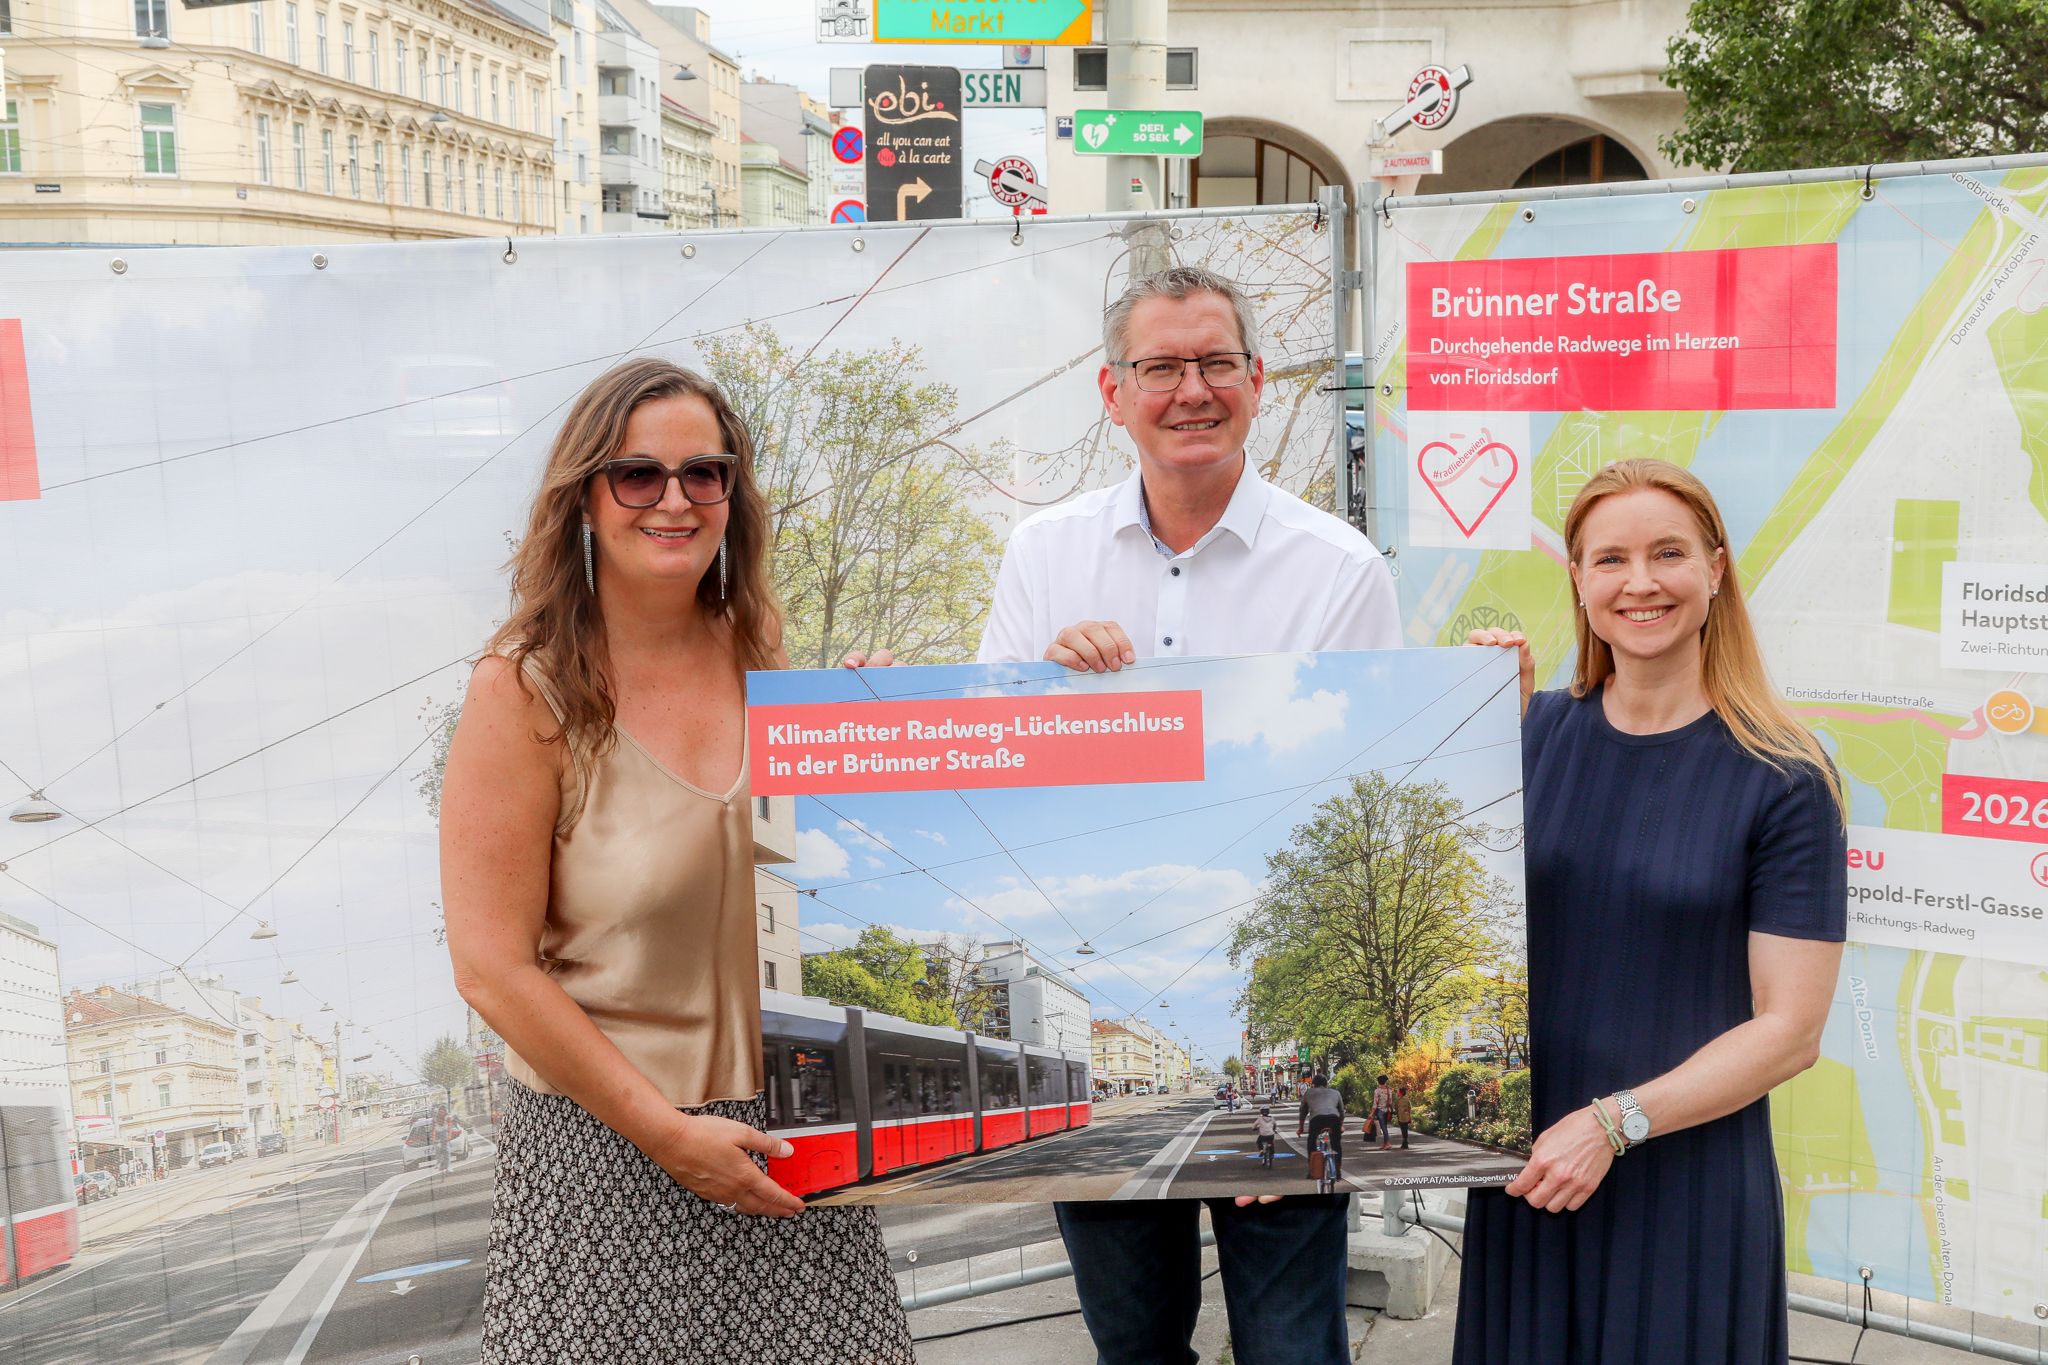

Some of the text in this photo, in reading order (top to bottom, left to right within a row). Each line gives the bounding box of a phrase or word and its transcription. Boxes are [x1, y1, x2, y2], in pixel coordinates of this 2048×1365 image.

[931, 9, 1004, 33] Markt
[965, 74, 1022, 103] SSEN
[1408, 70, 1441, 100] TABAK
[1419, 90, 1450, 125] TRAFIK
[877, 132, 950, 149] all you can eat
[1139, 124, 1164, 132] DEFI
[1149, 133, 1170, 142] SEK
[899, 150, 907, 164] à
[909, 149, 920, 164] la
[923, 153, 951, 164] carte
[998, 160, 1034, 179] TABAK
[1390, 157, 1430, 167] AUTOMATEN
[992, 178, 1025, 203] TRAFIK
[1431, 279, 1682, 318] Brünner Straße
[1950, 233, 2039, 346] Donauufer Autobahn
[1373, 320, 1400, 365] andelskai
[1430, 331, 1740, 358] Durchgehende Radwege im Herzen
[1430, 367, 1558, 385] von Floridsdorf
[1432, 437, 1486, 480] #radliebewien
[1963, 582, 2048, 603] Floridsd
[1962, 609, 2048, 634] Hauptst
[1785, 686, 1934, 709] Floridsdorfer Hauptstraße
[767, 711, 1185, 745] Klimafitter Radweg-Lückenschluss
[769, 746, 1025, 777] in der Brünner Straße
[1961, 791, 2048, 829] 2026
[1847, 848, 1885, 871] eu
[1847, 885, 2043, 920] opold-Ferstl-Gasse
[1848, 911, 1976, 940] i-Richtungs-Radweg
[1850, 977, 1877, 1060] Alte Donau
[1933, 1156, 1944, 1172] An
[1393, 1174, 1508, 1186] ZOOMVP.AT/Mobilitätsagentur
[1933, 1173, 1945, 1193] der
[1935, 1196, 1947, 1237] oberen
[1940, 1238, 1952, 1269] Alten
